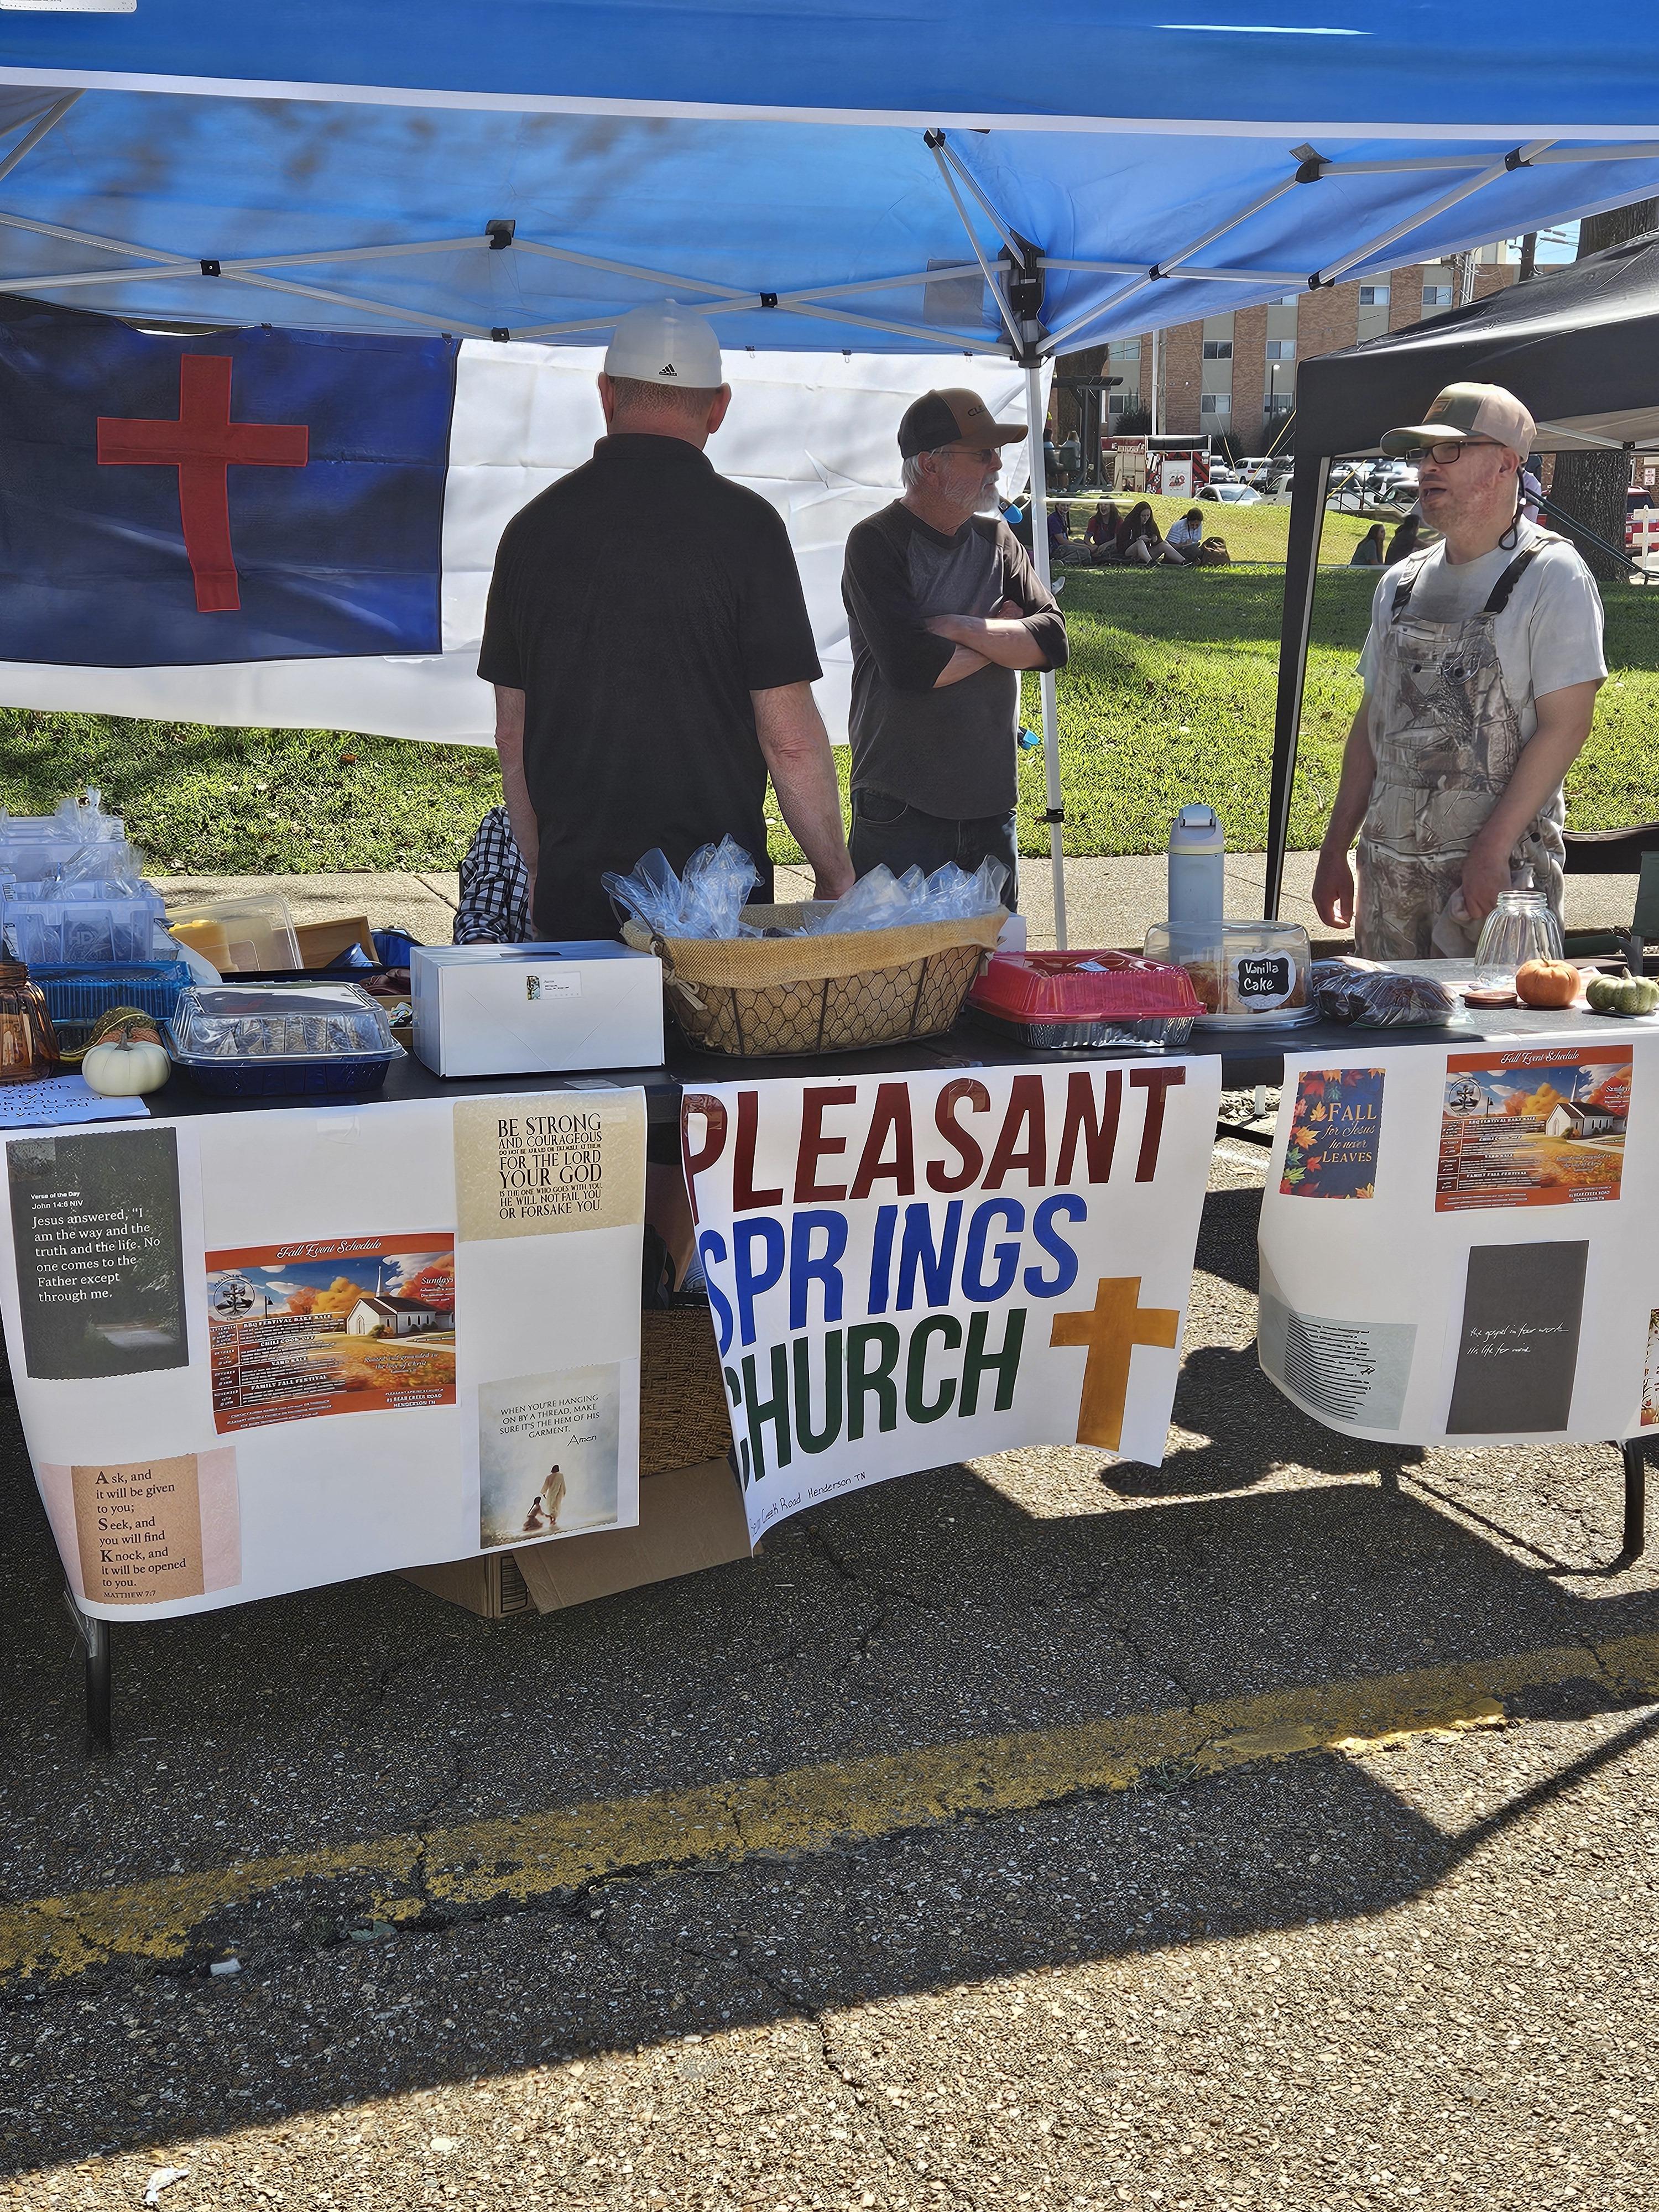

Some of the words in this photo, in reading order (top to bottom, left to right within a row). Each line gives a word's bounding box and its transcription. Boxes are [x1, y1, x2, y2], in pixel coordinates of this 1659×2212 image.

[1245, 962, 1279, 974] Vanilla
[1244, 977, 1275, 992] Cake
[1500, 1052, 1521, 1064] Fall
[1327, 1103, 1377, 1121] FALL
[498, 1118, 519, 1137] BE
[525, 1113, 602, 1136] STRONG
[1321, 1124, 1340, 1140] for
[1342, 1120, 1375, 1137] Jesus
[499, 1137, 523, 1149] AND
[527, 1131, 602, 1147] COURAGEOUS
[681, 1065, 1186, 1225] PLEASANT
[500, 1155, 526, 1170] FOR
[532, 1152, 559, 1167] THE
[564, 1150, 601, 1165] LORD
[1322, 1151, 1372, 1162] LEAVES
[498, 1167, 552, 1189] YOUR
[560, 1164, 602, 1184] GOD
[500, 1197, 513, 1207] HE
[516, 1195, 537, 1205] WILL
[540, 1193, 559, 1203] NOT
[562, 1191, 579, 1201] FAIL
[583, 1189, 601, 1199] YOU
[499, 1207, 516, 1219] OR
[521, 1202, 572, 1218] FORSAKE
[577, 1199, 603, 1212] YOU.
[31, 1216, 64, 1229] Jesus
[67, 1208, 128, 1224] answered,
[34, 1233, 53, 1242] am
[56, 1229, 76, 1240] the
[79, 1229, 102, 1239] way
[106, 1224, 128, 1237] and
[132, 1222, 150, 1234] the
[35, 1245, 67, 1257] truth
[70, 1243, 92, 1255] and
[96, 1241, 115, 1253] the
[118, 1239, 140, 1251] life.
[144, 1237, 160, 1248] No
[277, 1245, 304, 1259] Fall
[36, 1263, 58, 1272] one
[61, 1260, 99, 1271] comes
[102, 1258, 114, 1267] to
[117, 1254, 137, 1266] the
[38, 1275, 77, 1287] Father
[80, 1272, 120, 1285] except
[698, 1193, 1088, 1358] SPRINGS
[39, 1289, 87, 1303] through
[1469, 1327, 1482, 1337] the
[1510, 1324, 1517, 1334] in
[1494, 1342, 1510, 1357] for
[500, 1405, 526, 1415] WHEN
[528, 1400, 556, 1411] YOU'RE
[559, 1394, 598, 1406] HANGING
[503, 1416, 516, 1425] ON
[573, 1404, 596, 1412] MAKE
[499, 1425, 519, 1434] SURE
[521, 1422, 534, 1431] IT'S
[538, 1419, 552, 1427] THE
[554, 1416, 571, 1425] HEM
[529, 1425, 570, 1438] GARMENT.
[567, 1434, 597, 1447] Amen
[131, 1469, 152, 1481] and
[96, 1489, 103, 1500] it
[106, 1488, 127, 1499] will
[130, 1486, 143, 1496] be
[146, 1484, 175, 1498] given
[780, 1492, 801, 1511] Road
[808, 1477, 851, 1499] Henderson
[854, 1472, 866, 1481] TN
[97, 1505, 108, 1514] to
[111, 1504, 134, 1516] you;
[135, 1516, 155, 1528] and
[99, 1536, 118, 1547] you
[122, 1533, 141, 1545] will
[144, 1530, 165, 1542] find
[148, 1546, 168, 1558] and
[101, 1566, 108, 1575] it
[111, 1564, 130, 1575] will
[133, 1563, 145, 1574] be
[148, 1558, 186, 1574] opened
[102, 1578, 112, 1587] to
[114, 1578, 137, 1589] you.
